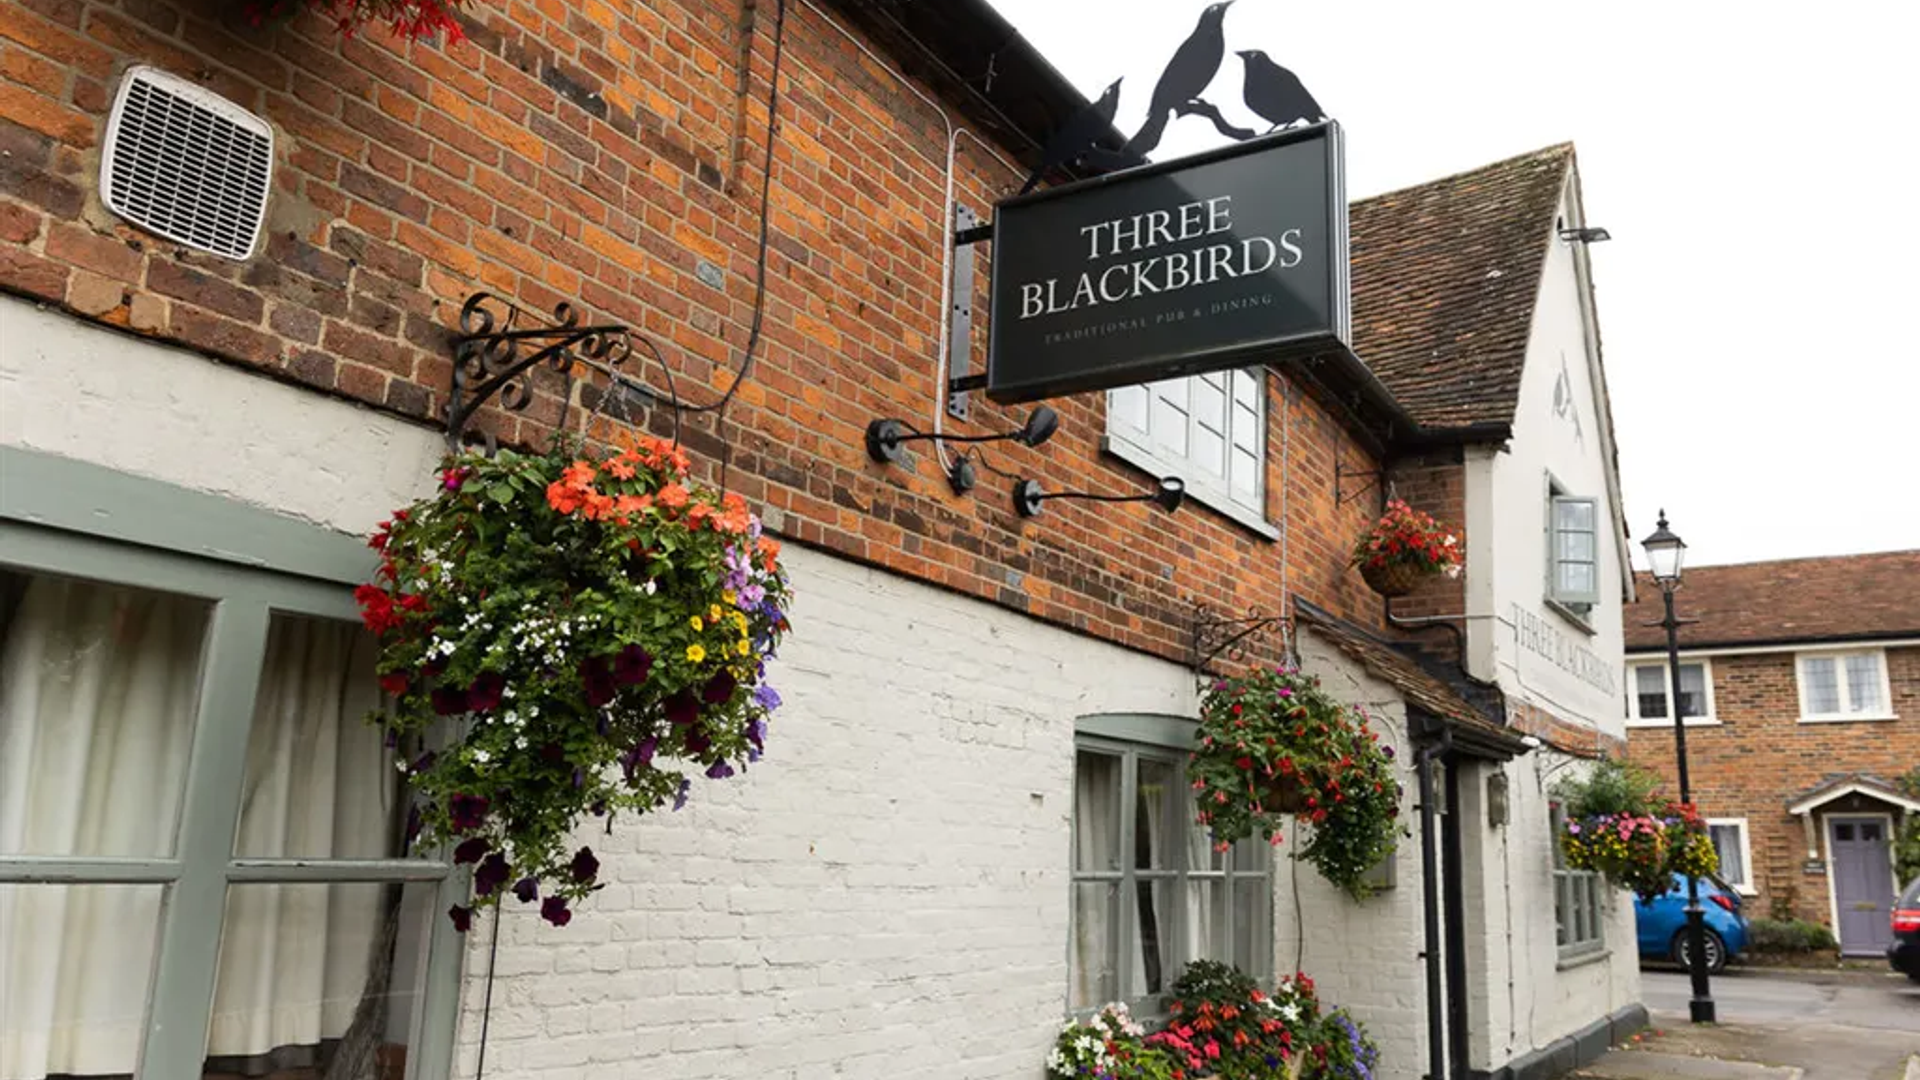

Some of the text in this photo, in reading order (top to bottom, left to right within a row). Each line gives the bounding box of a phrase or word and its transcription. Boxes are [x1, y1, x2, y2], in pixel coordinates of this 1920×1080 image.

[1080, 195, 1233, 261] THREE
[1019, 228, 1303, 320] BLACKBIRDS
[1044, 294, 1272, 345] TRADITIONAL PUB & DINING
[1510, 600, 1553, 663] THREE
